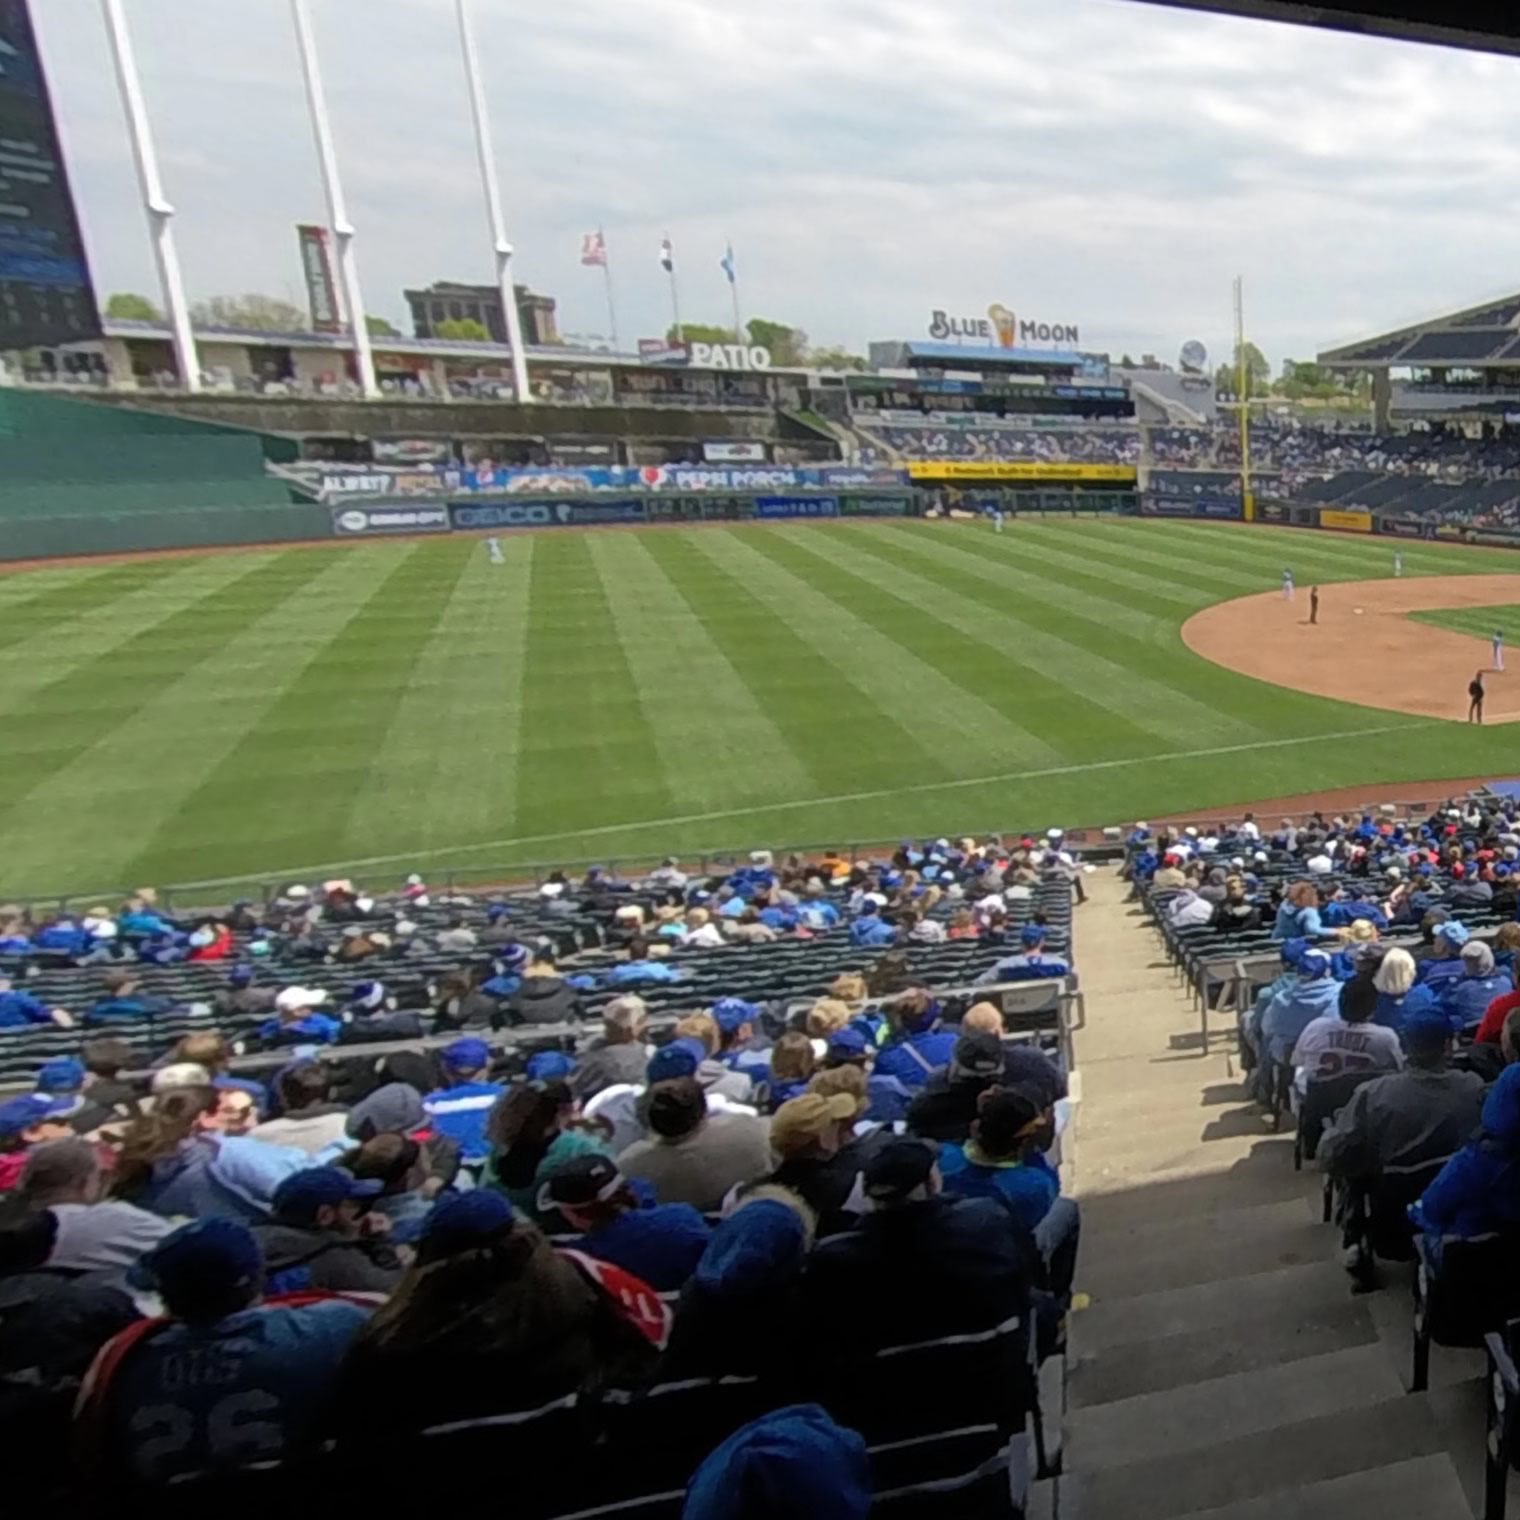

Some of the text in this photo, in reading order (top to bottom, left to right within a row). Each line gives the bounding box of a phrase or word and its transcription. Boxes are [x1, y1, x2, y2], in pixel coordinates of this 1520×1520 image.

[929, 310, 1079, 342] BLUE MOON
[688, 342, 771, 371] PATIO
[676, 471, 728, 490] PEPSI
[453, 505, 549, 526] GEICO
